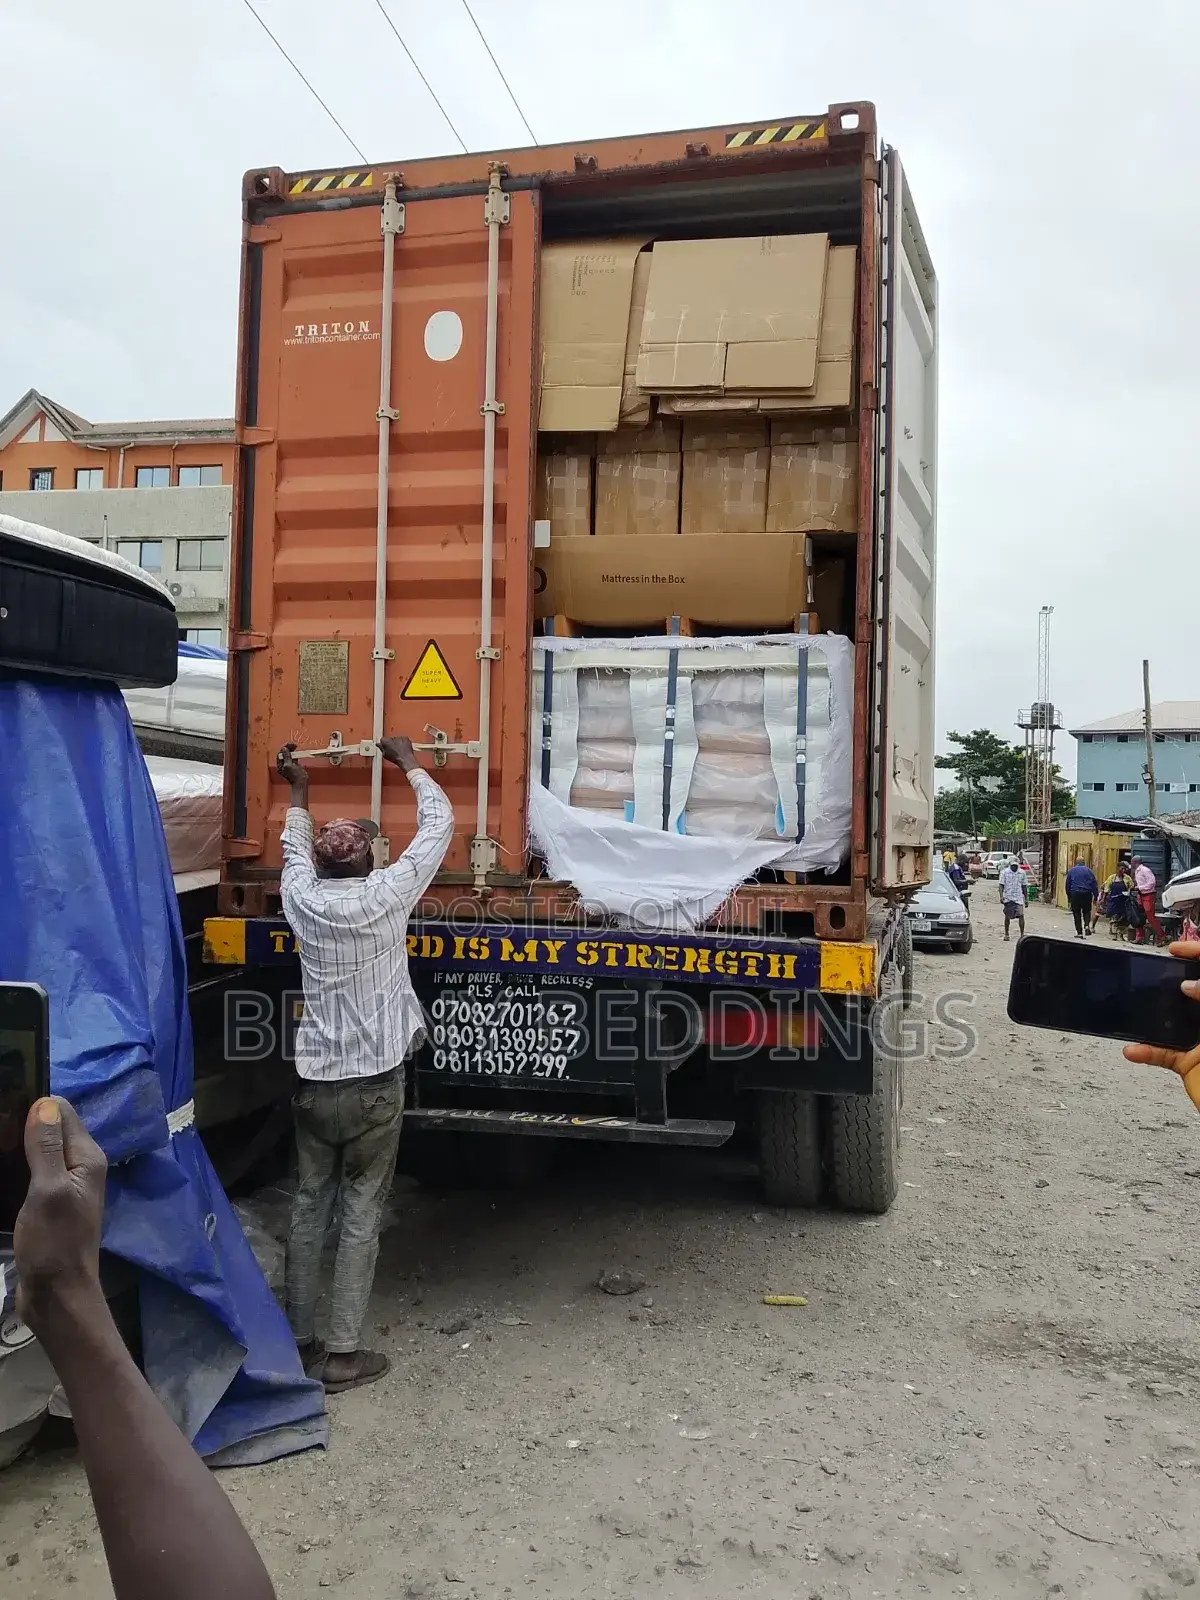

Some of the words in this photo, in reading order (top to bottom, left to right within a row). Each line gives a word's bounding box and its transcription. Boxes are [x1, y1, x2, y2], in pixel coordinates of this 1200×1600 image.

[295, 320, 370, 337] TRITON
[284, 331, 380, 346] www.tritoncontainer.com
[601, 574, 640, 584] Mattress
[641, 574, 650, 584] in
[651, 574, 667, 584] the
[668, 575, 686, 584] Box
[269, 931, 301, 953] T
[405, 934, 444, 958] RD
[452, 936, 490, 960] IS
[500, 938, 567, 964] MY
[576, 940, 798, 980] STRENGTH
[433, 973, 443, 984] IF
[445, 973, 464, 984] MY
[541, 974, 594, 989] RECKLESS
